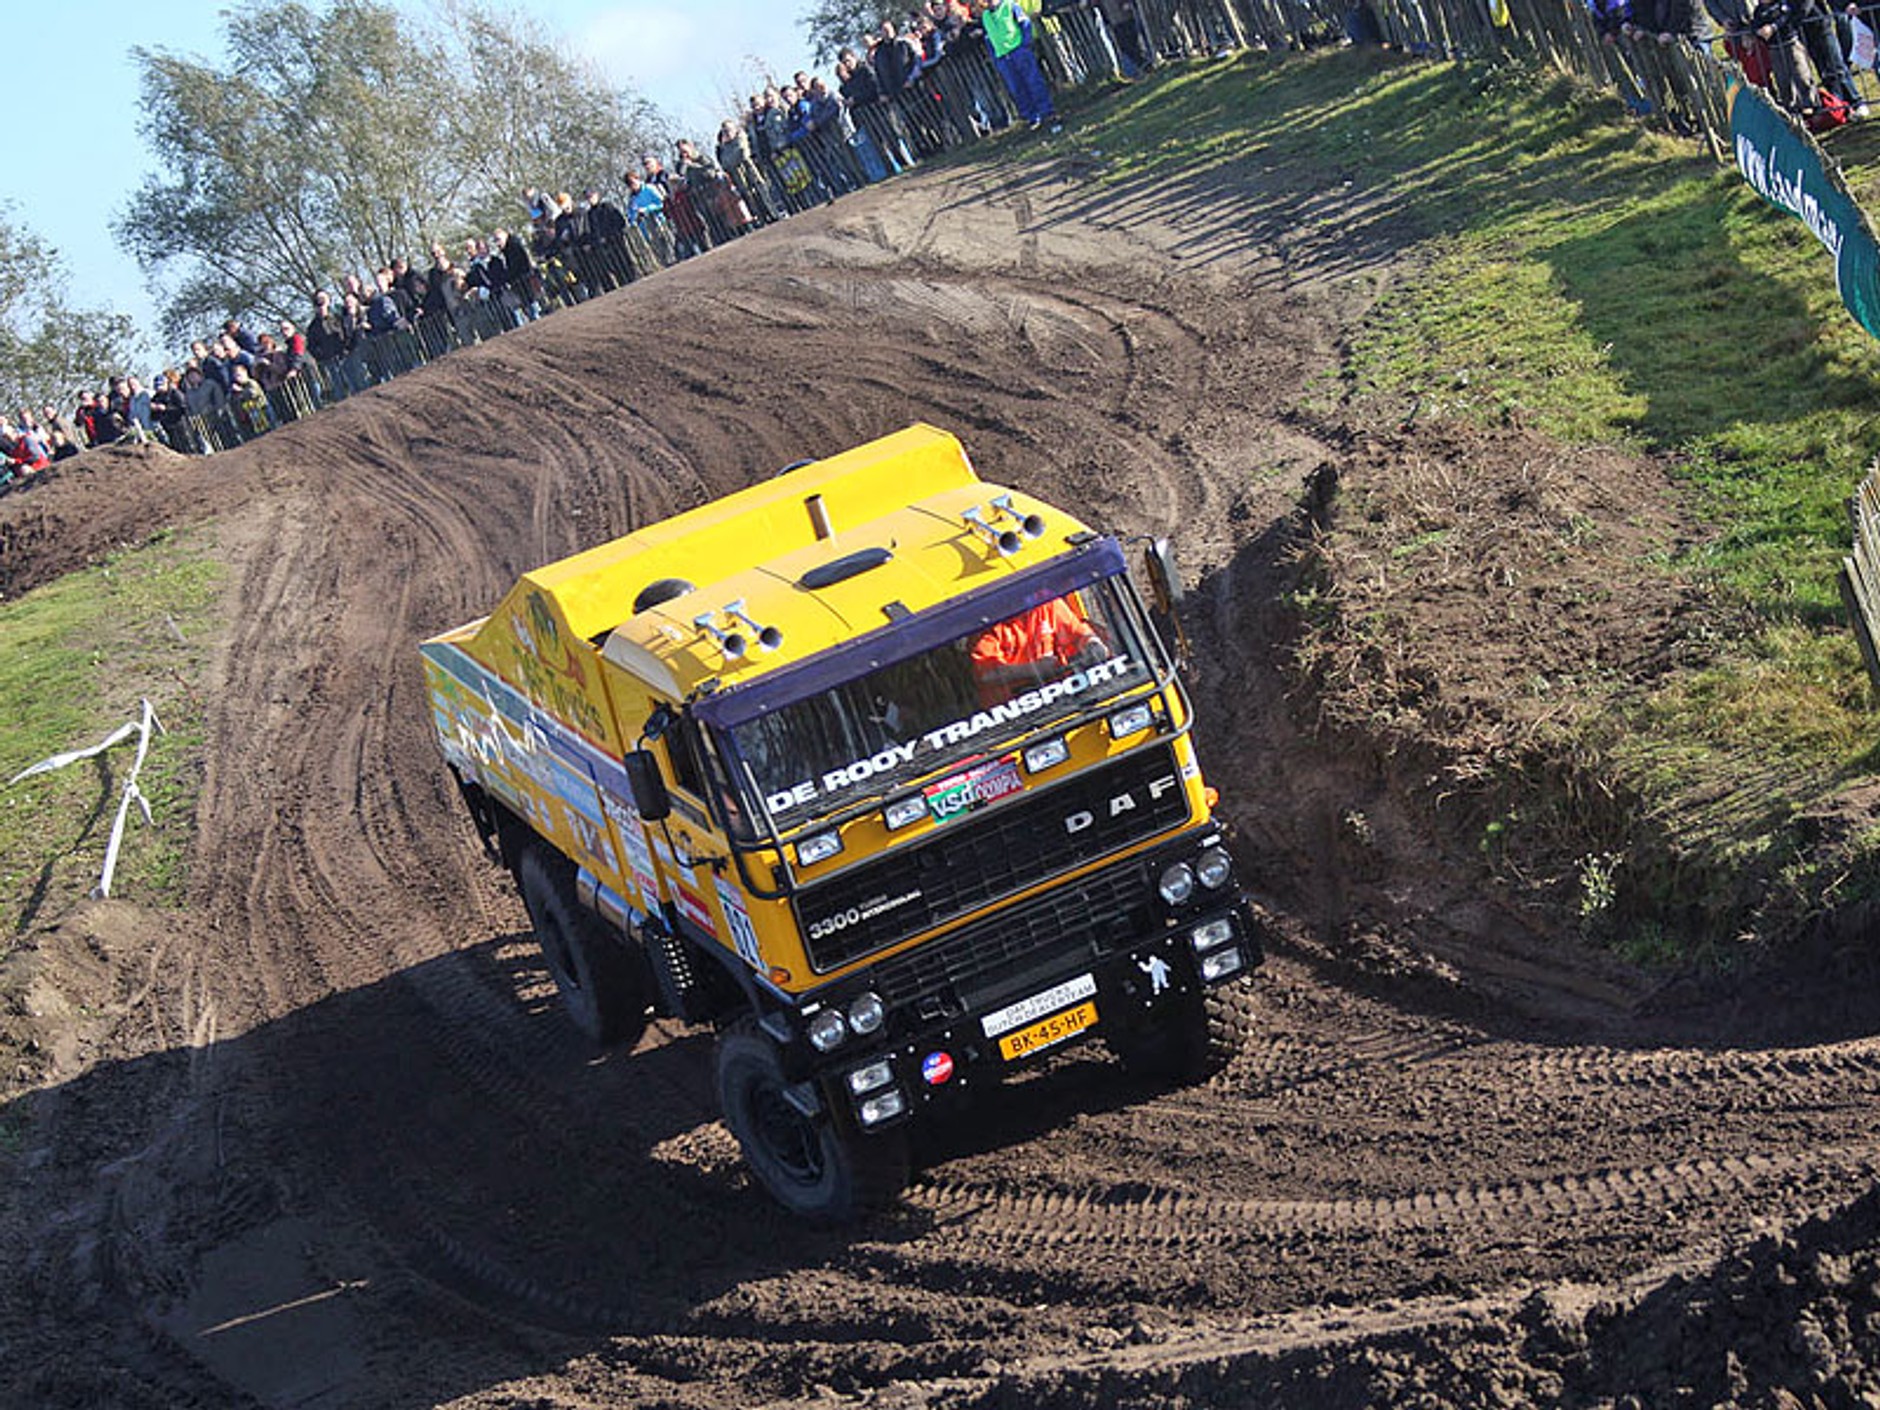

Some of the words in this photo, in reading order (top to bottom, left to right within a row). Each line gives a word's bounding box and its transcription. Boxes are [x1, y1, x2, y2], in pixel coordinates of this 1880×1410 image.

[766, 780, 818, 814] DE
[822, 740, 917, 792] ROOY
[923, 654, 1129, 750] TRANSPORT
[809, 908, 860, 939] 3300
[1010, 1008, 1087, 1053] BK-45-HF
